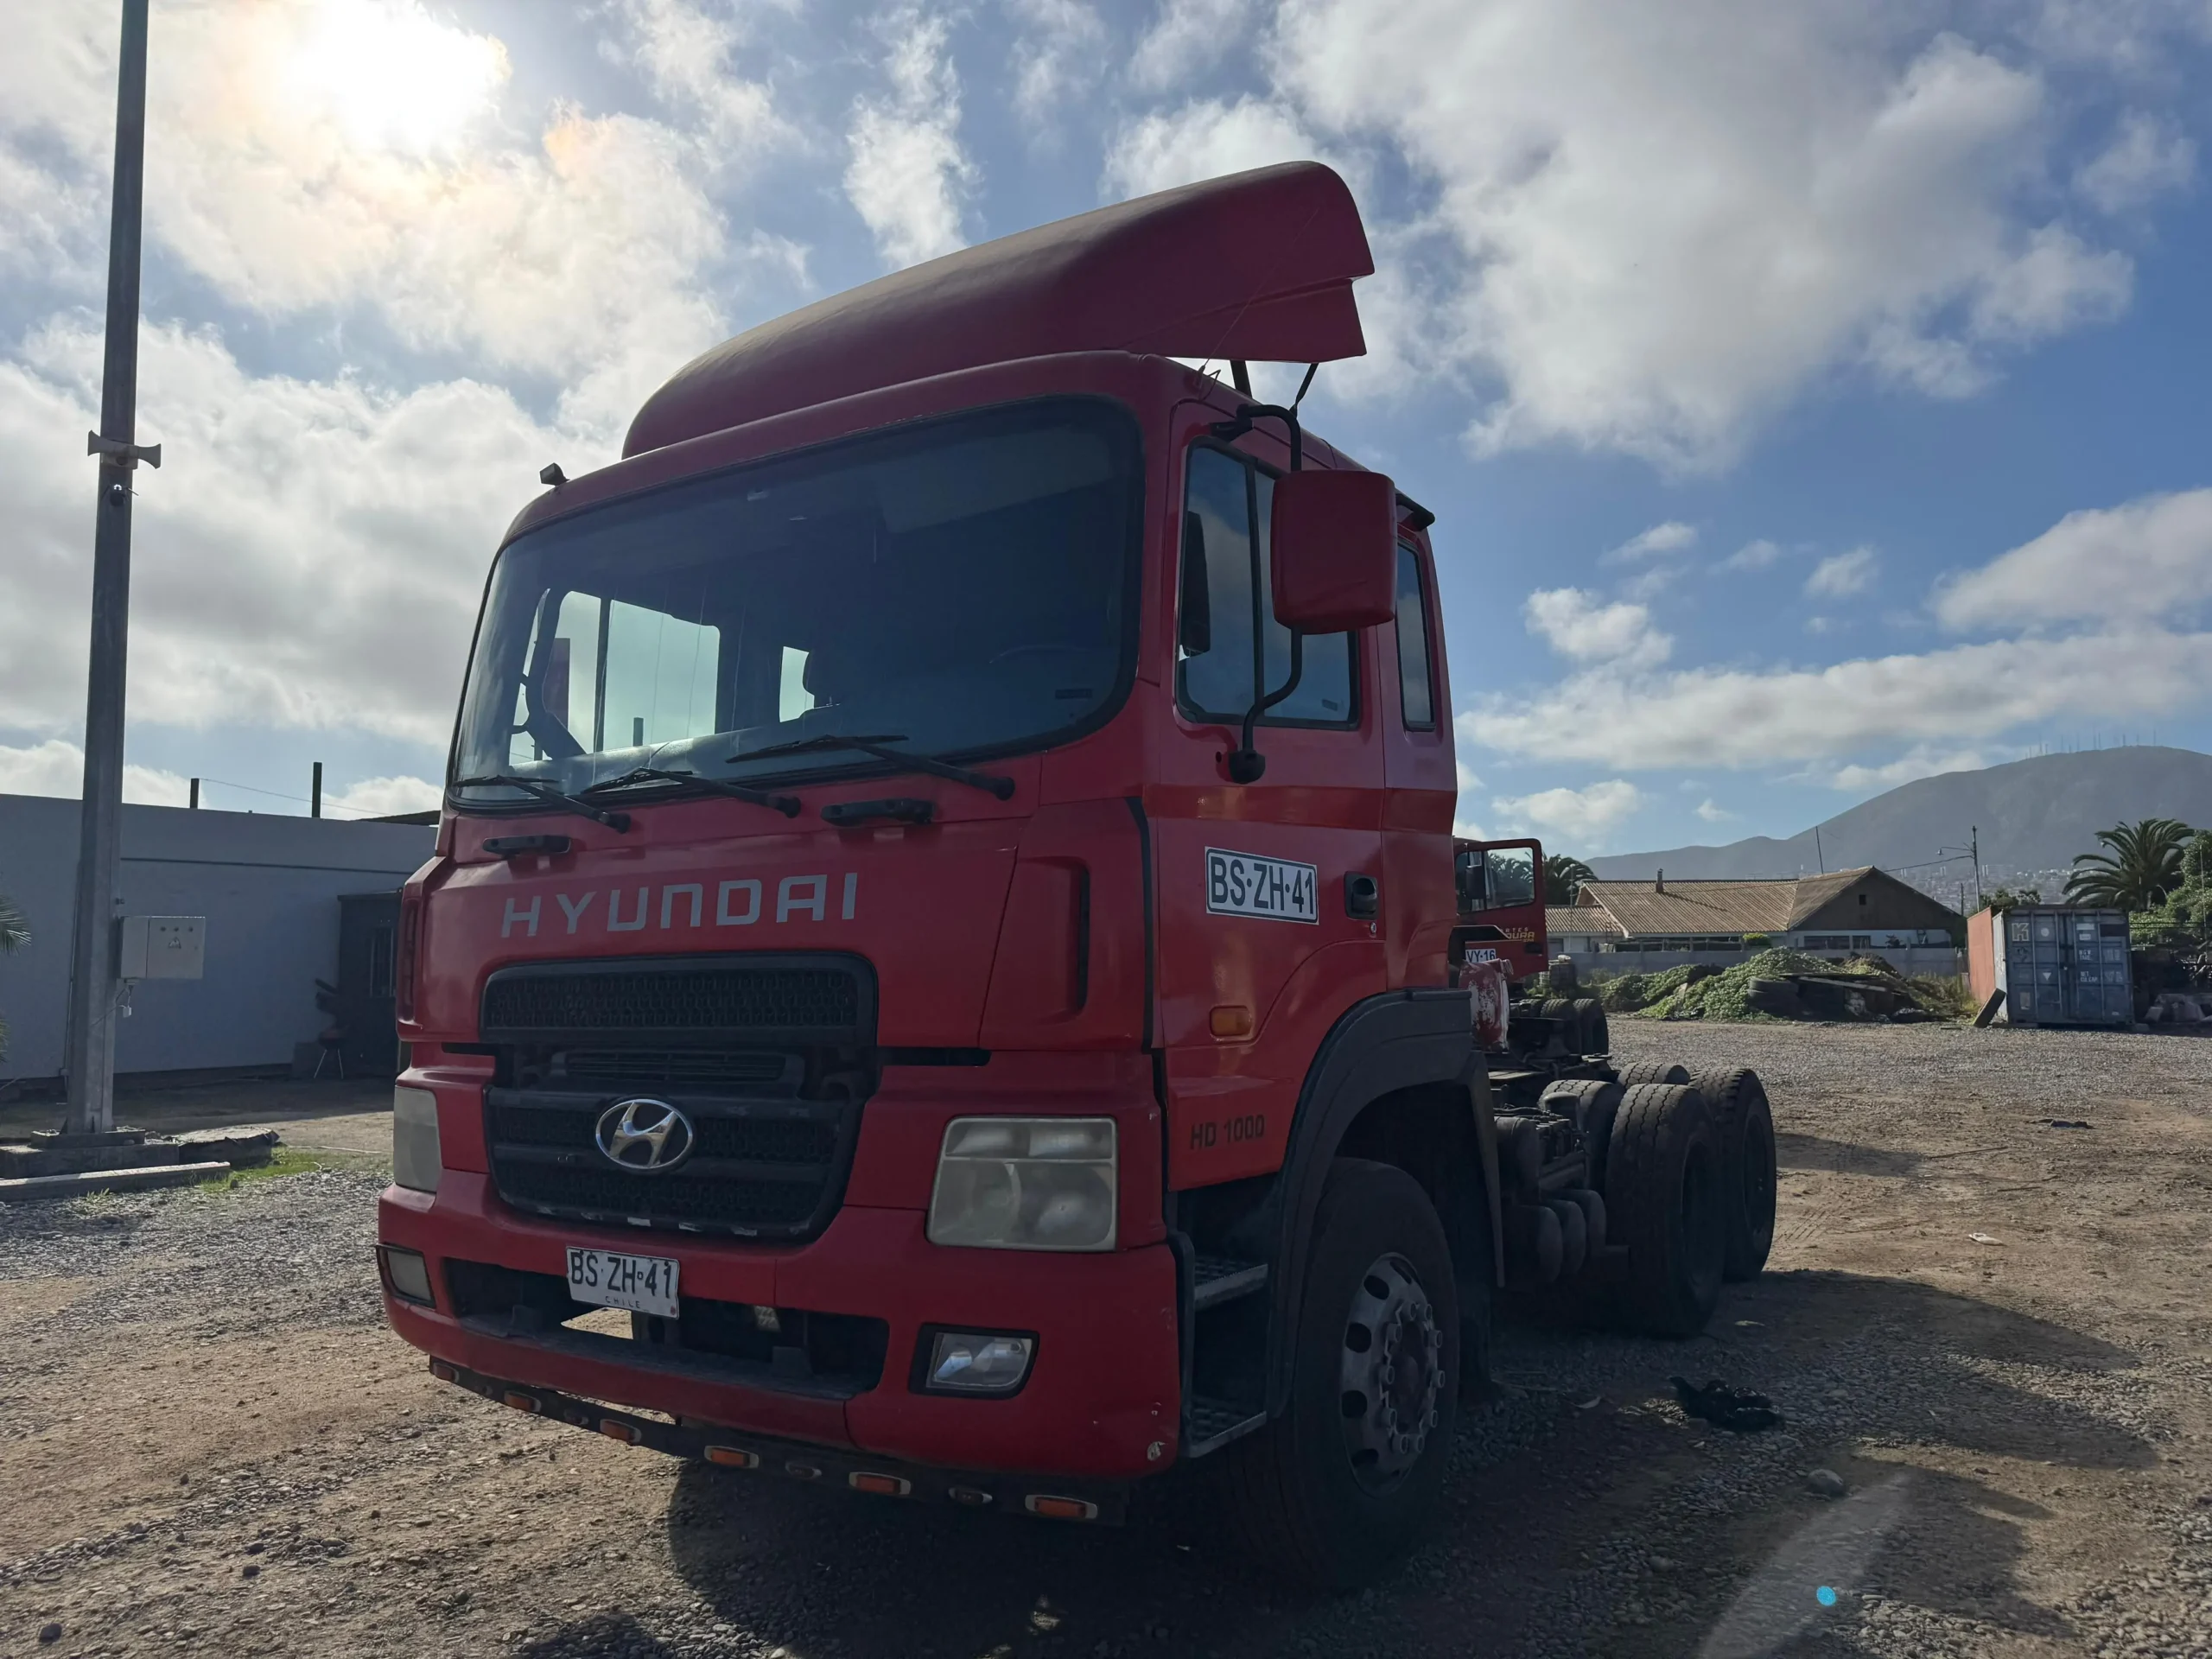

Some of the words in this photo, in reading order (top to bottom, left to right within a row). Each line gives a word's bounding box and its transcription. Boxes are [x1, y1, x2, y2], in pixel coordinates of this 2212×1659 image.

[501, 872, 858, 938] HYUNDAI
[1190, 1122, 1217, 1150] HD
[1224, 1114, 1264, 1143] 1000
[605, 1295, 640, 1309] CHILE
